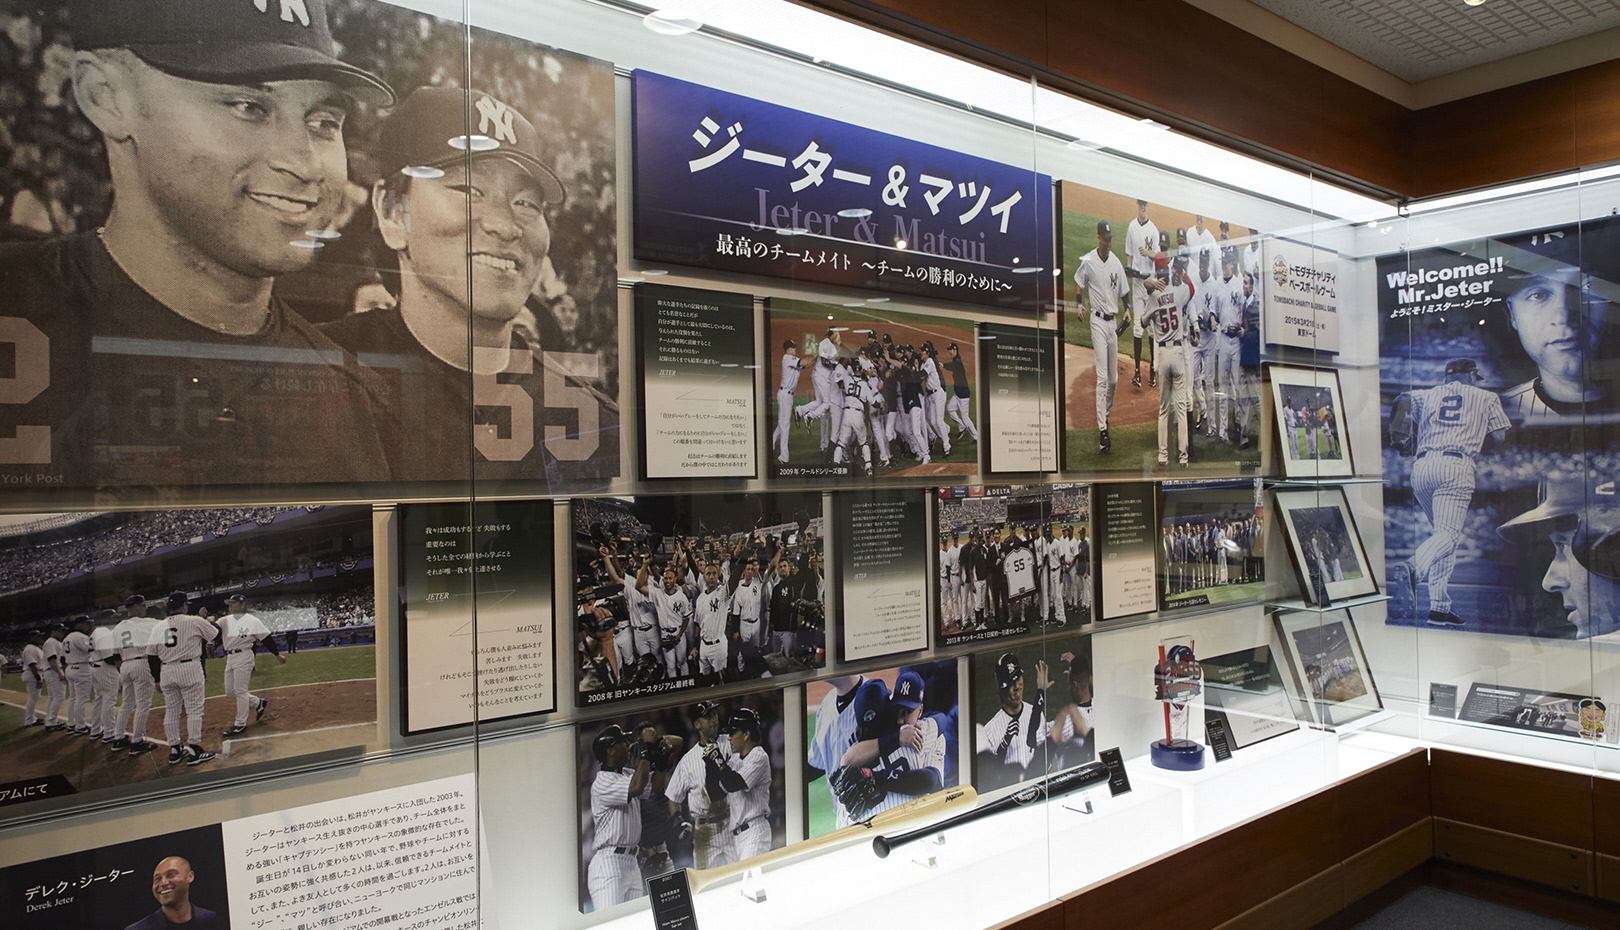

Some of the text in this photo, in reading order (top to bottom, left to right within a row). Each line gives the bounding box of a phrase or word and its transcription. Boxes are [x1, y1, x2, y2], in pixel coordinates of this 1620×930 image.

[749, 186, 988, 265] Jeter & Matsui
[715, 232, 851, 271] 最高のチームメイト
[1289, 263, 1336, 285] トモダチチャリティ
[1386, 256, 1504, 289] Welcome!!
[1289, 280, 1336, 299] ベースボールゲーム
[1397, 279, 1494, 305] Mr.Jeter
[1159, 306, 1179, 334] 55
[473, 345, 600, 461] 55
[1438, 394, 1463, 421] 2
[1, 472, 64, 485] York Post
[779, 467, 848, 476] 2009年 ワールドシリーズ優勝
[991, 488, 1011, 496] DELTA
[425, 524, 482, 535] 我々は成功もするど
[425, 540, 457, 549] 重要なのは
[1013, 558, 1025, 573] 55
[425, 591, 450, 601] JETER
[164, 627, 178, 648] 6
[515, 624, 543, 633] MATSUI
[471, 641, 543, 655] ろん僕も人並みに悩みます
[946, 636, 961, 645] 2013年
[485, 652, 543, 665] 苦しみます 失敗します
[460, 682, 544, 700] マイナをどうプラスに変えていくか
[588, 678, 695, 703] 2008年 旧ヤンキースタジアム最終戦
[468, 692, 544, 709] いもそんなことを考えています
[0, 783, 49, 801] アムにて
[25, 869, 134, 901] デレク・ジーター
[26, 896, 75, 913] Derek Jeter
